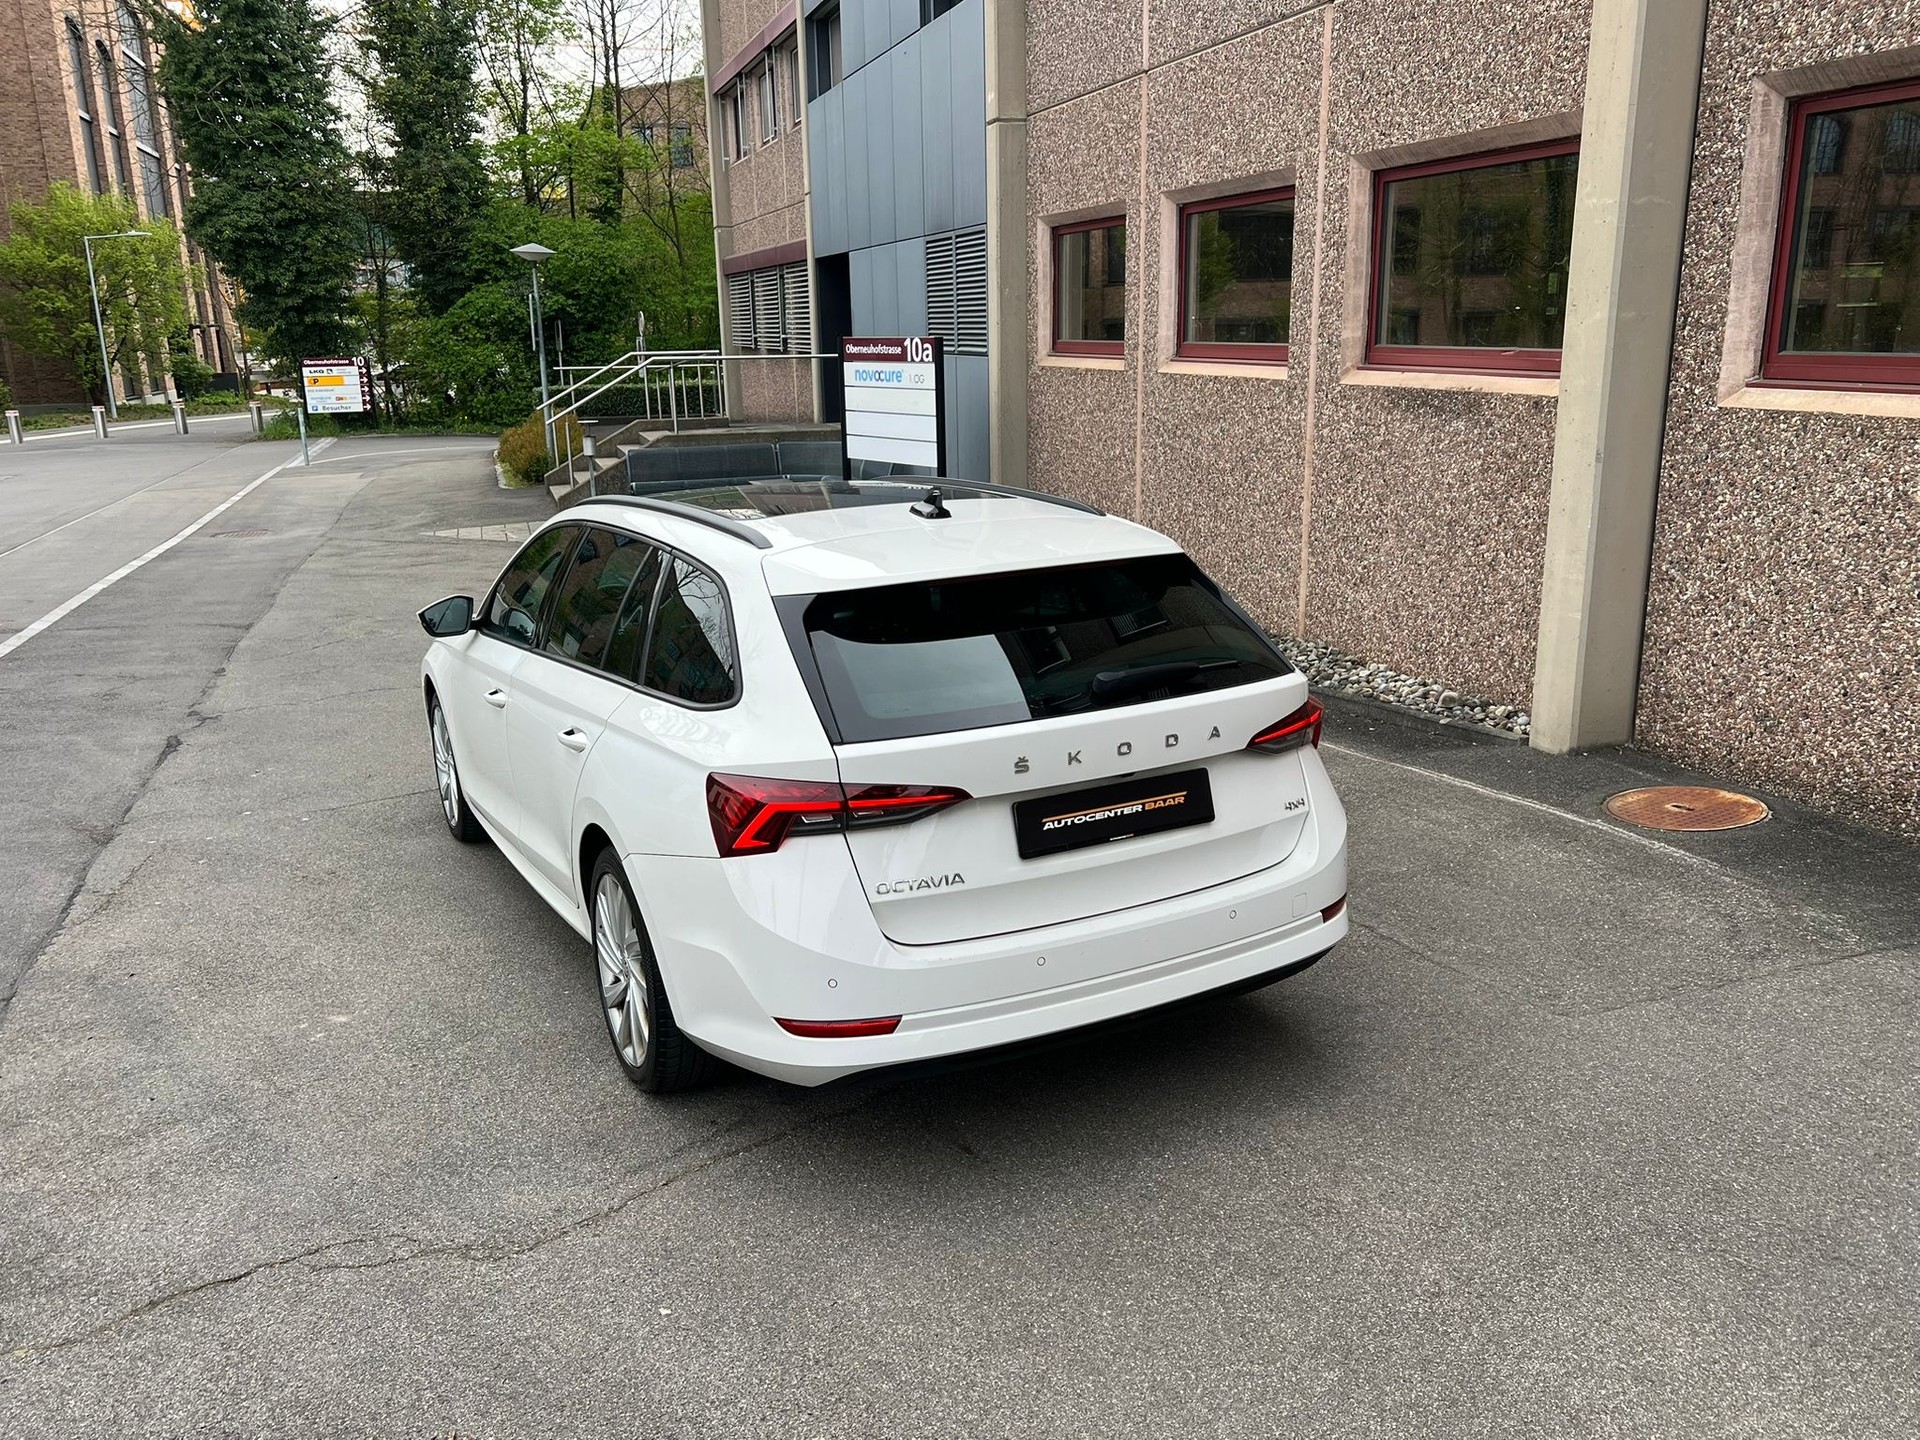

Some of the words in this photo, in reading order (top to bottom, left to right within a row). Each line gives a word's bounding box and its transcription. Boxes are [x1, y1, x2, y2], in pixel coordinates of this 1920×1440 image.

[351, 356, 365, 366] 10
[845, 343, 902, 354] Oberneuhofstrasse
[904, 336, 933, 362] 10a
[854, 369, 903, 382] novocure
[1014, 725, 1221, 774] ŠKODA
[1043, 804, 1143, 831] AUTOCENTER
[1144, 796, 1185, 811] BAAR
[876, 872, 965, 895] OCTAVIA
